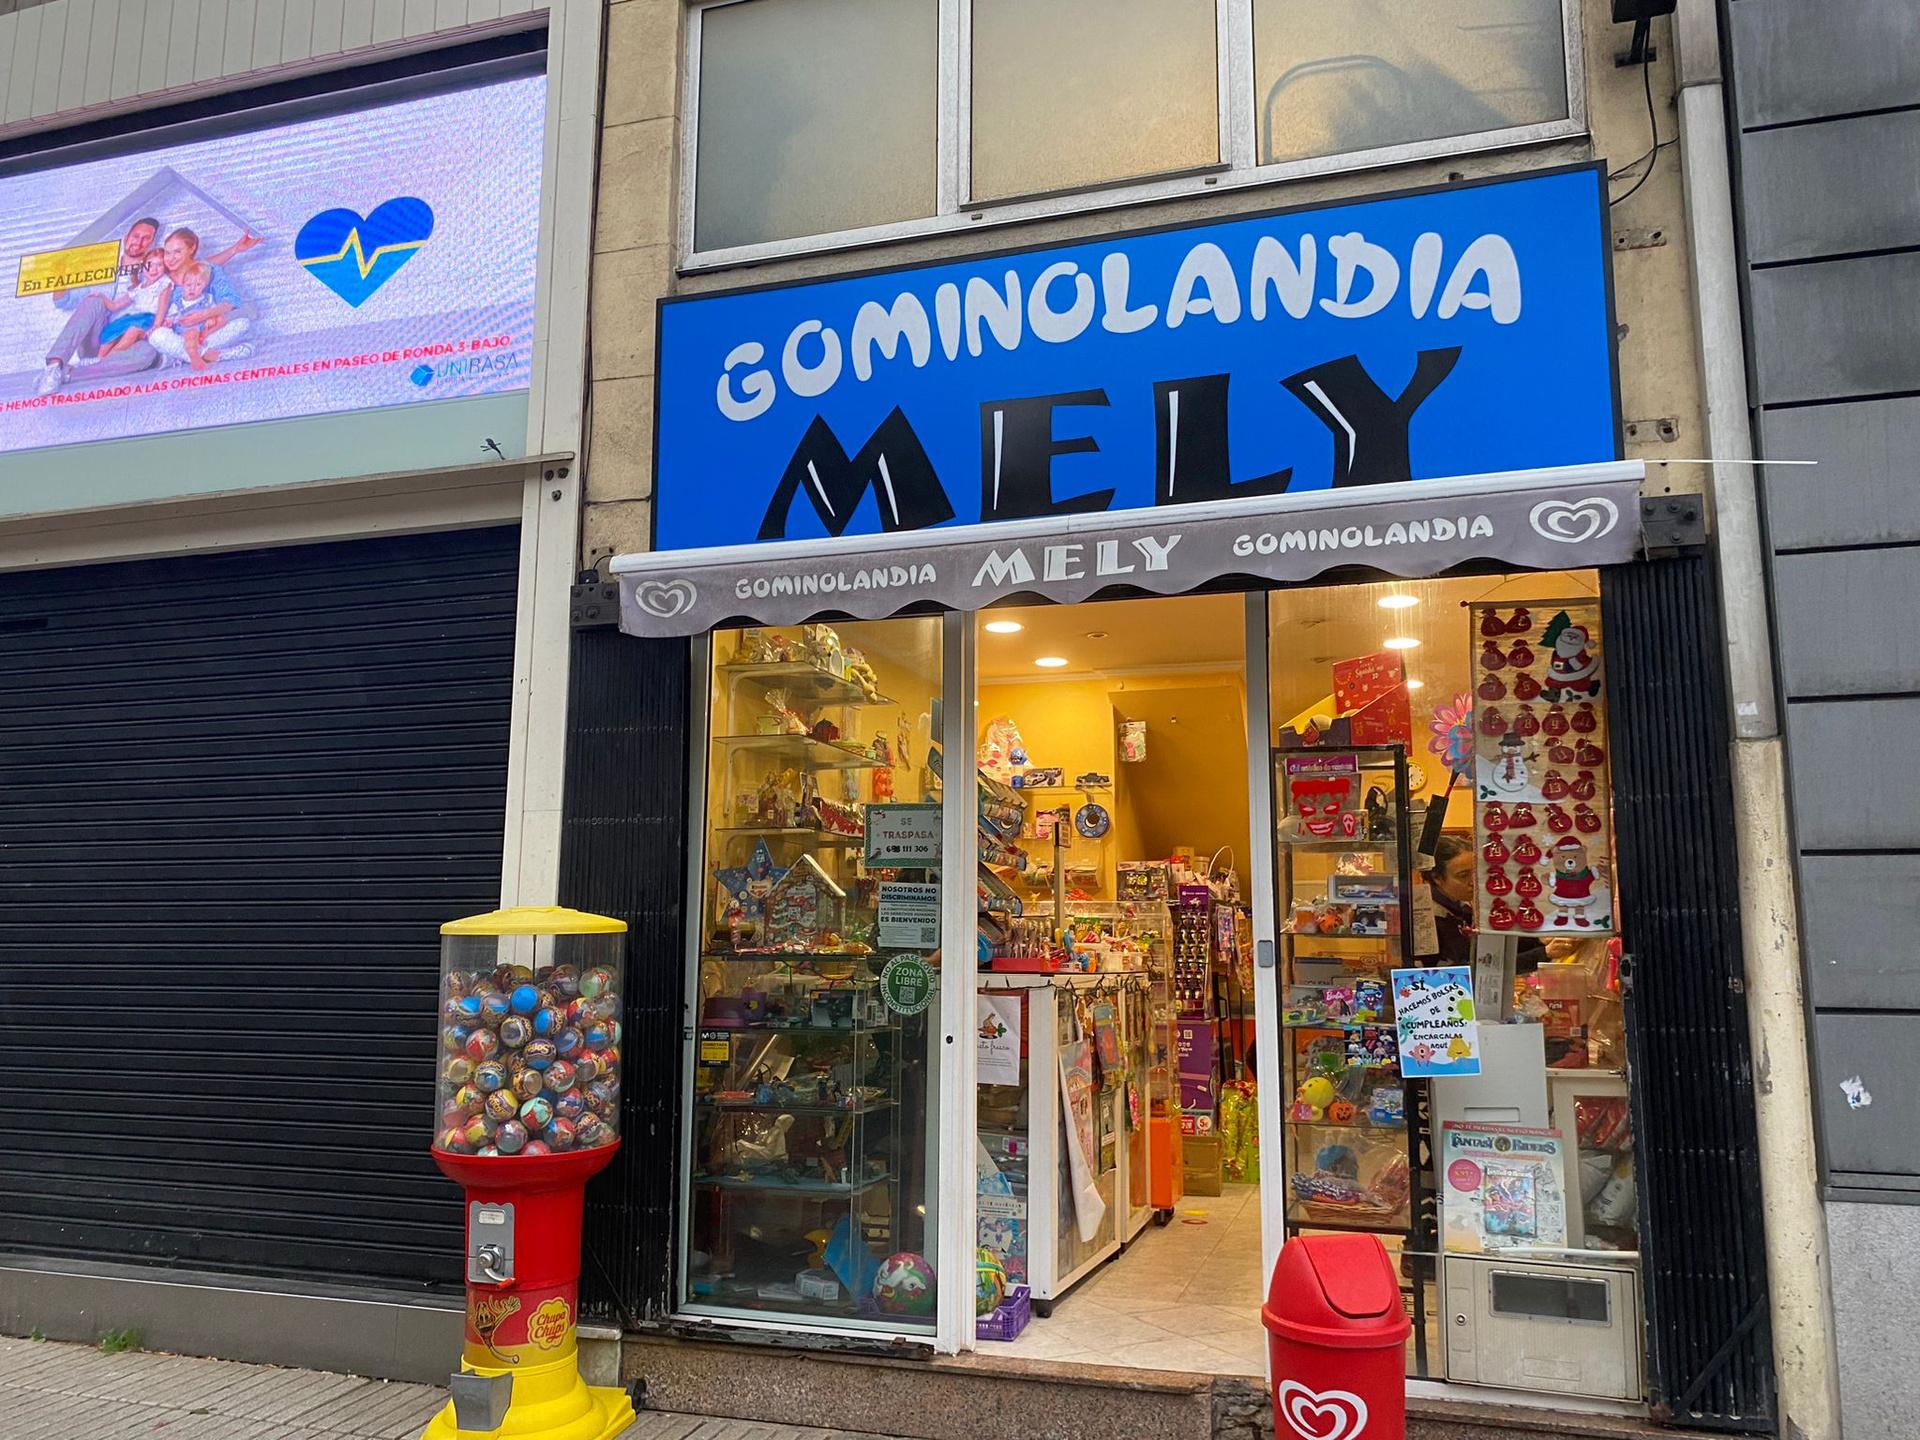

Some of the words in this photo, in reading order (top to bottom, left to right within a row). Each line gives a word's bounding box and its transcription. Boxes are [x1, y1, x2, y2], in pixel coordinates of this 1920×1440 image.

[23, 280, 41, 292] En
[717, 232, 1521, 422] GOMINOLANDIA
[6, 396, 48, 411] HEMOS
[51, 386, 131, 406] TRASLADADO
[134, 385, 143, 394] A
[145, 381, 168, 393] LAS
[171, 373, 230, 389] OFICINAS
[234, 362, 309, 382] CENTRALES
[313, 361, 331, 372] EN
[334, 354, 379, 368] PASEO
[382, 352, 401, 363] DE
[403, 343, 453, 360] RONDA
[471, 335, 511, 350] BAJO
[435, 352, 519, 378] UNIRASA
[756, 346, 1463, 540] MELY
[1232, 515, 1493, 557] GOMINOLANDIA
[971, 534, 1182, 588] MELY
[735, 563, 936, 599] GOMINOLANDIA
[900, 817, 913, 826] SE
[882, 830, 935, 839] TRASPASA
[881, 894, 937, 902] DISCRIMINAMOS
[890, 916, 937, 924] BIENVENIDO
[882, 967, 891, 979] NO
[890, 958, 900, 968] AL
[900, 954, 920, 963] PASE
[895, 966, 923, 977] ZONA
[895, 975, 923, 987] LIBRE
[880, 983, 937, 1013] INCONSTITUCIONAL
[1398, 994, 1431, 1016] HACEMOS
[1432, 981, 1459, 1000] BOLSAS
[1429, 1006, 1441, 1015] DE
[1451, 1132, 1494, 1150] FANTASY
[536, 1311, 566, 1325] Chupa
[534, 1324, 565, 1343] Chups
